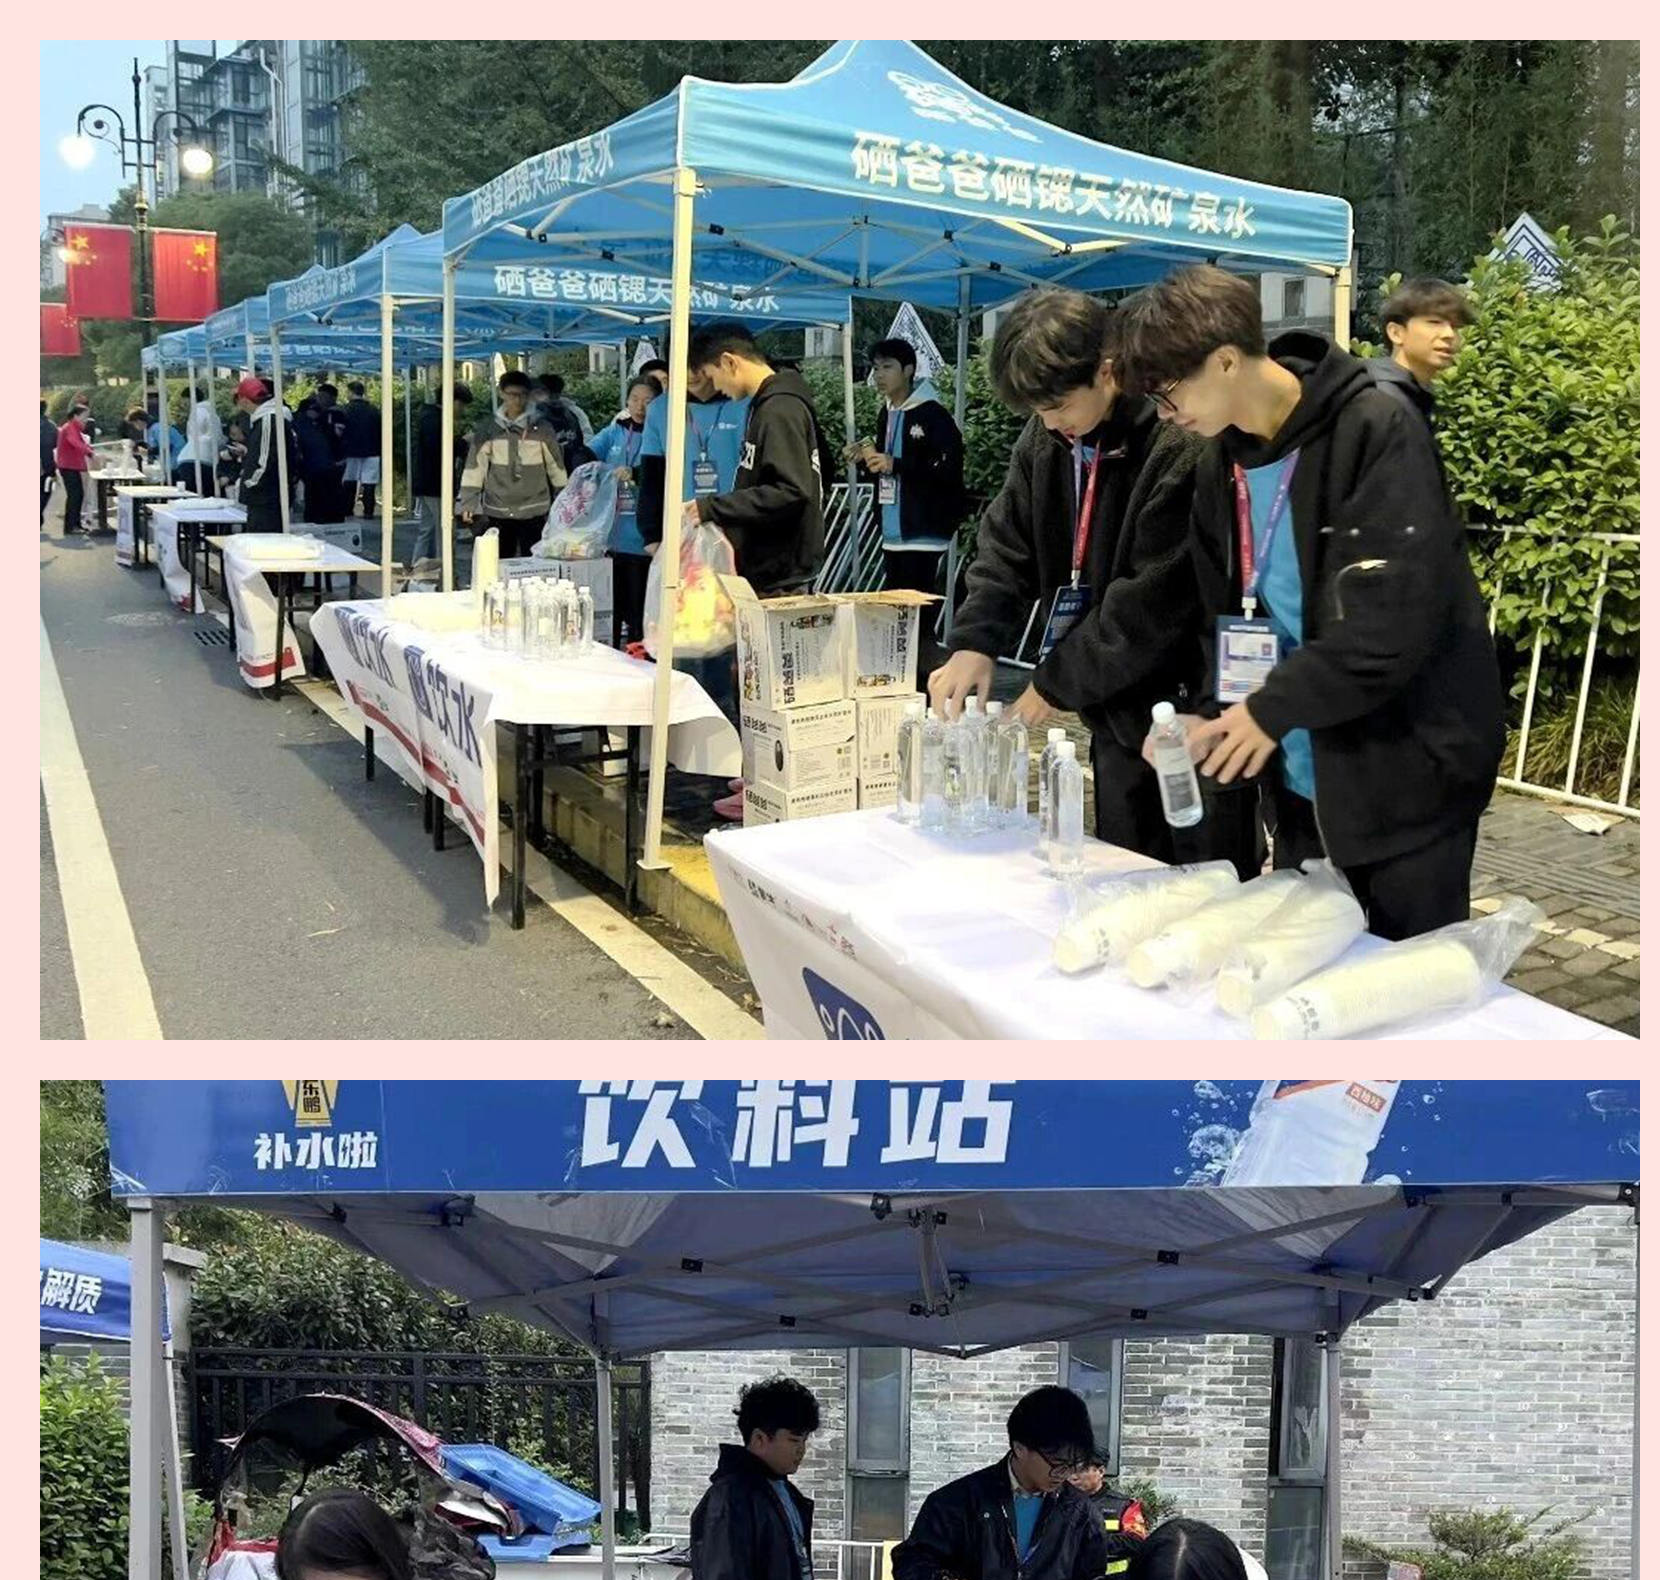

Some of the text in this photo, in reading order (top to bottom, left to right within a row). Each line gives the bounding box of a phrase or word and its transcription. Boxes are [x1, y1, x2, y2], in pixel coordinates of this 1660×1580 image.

[852, 130, 1257, 240] 硒爸爸硒锶天然矿泉水
[253, 1131, 378, 1169] 补水啦
[579, 1080, 1016, 1168] 饮料站
[40, 1267, 102, 1315] 解质
